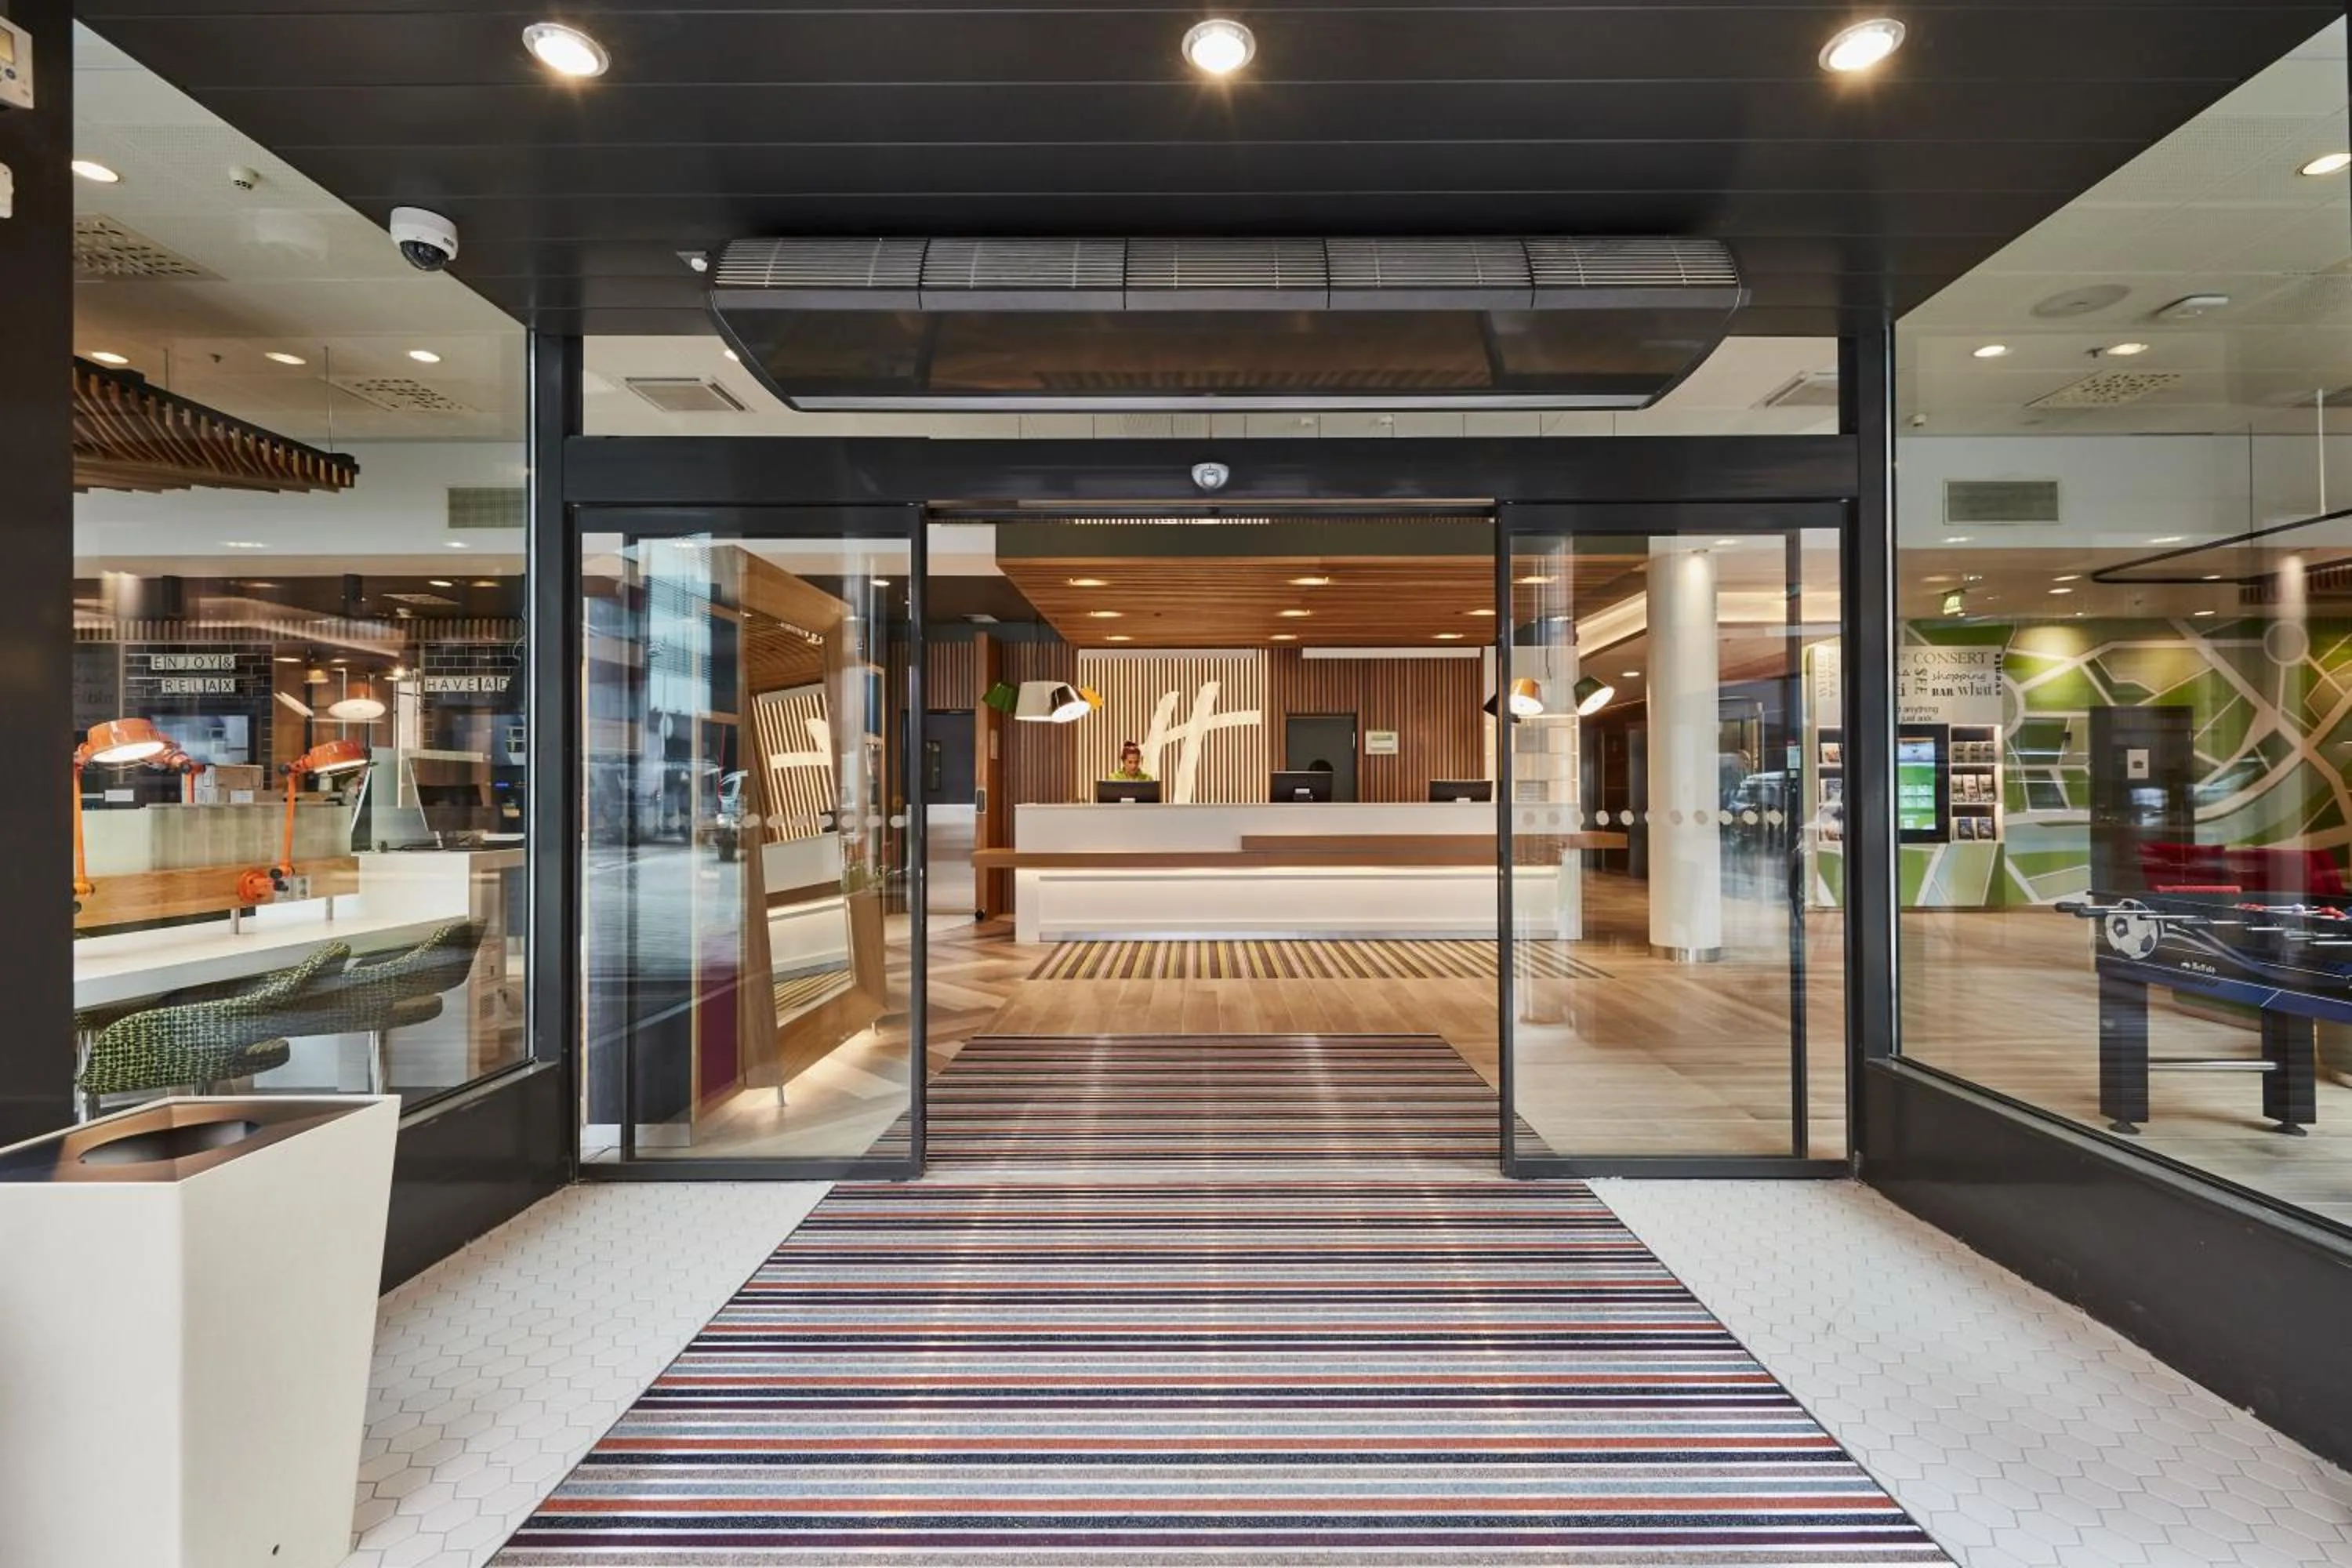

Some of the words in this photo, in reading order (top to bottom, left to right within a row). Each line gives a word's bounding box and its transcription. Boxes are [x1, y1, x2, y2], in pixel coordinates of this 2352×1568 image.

[154, 657, 216, 669] ENJOY
[1913, 652, 1988, 665] CONSERT
[1932, 670, 1987, 682] shopping
[164, 679, 232, 691] RELAX
[426, 678, 475, 691] HAVE
[1931, 687, 1955, 697] BAR
